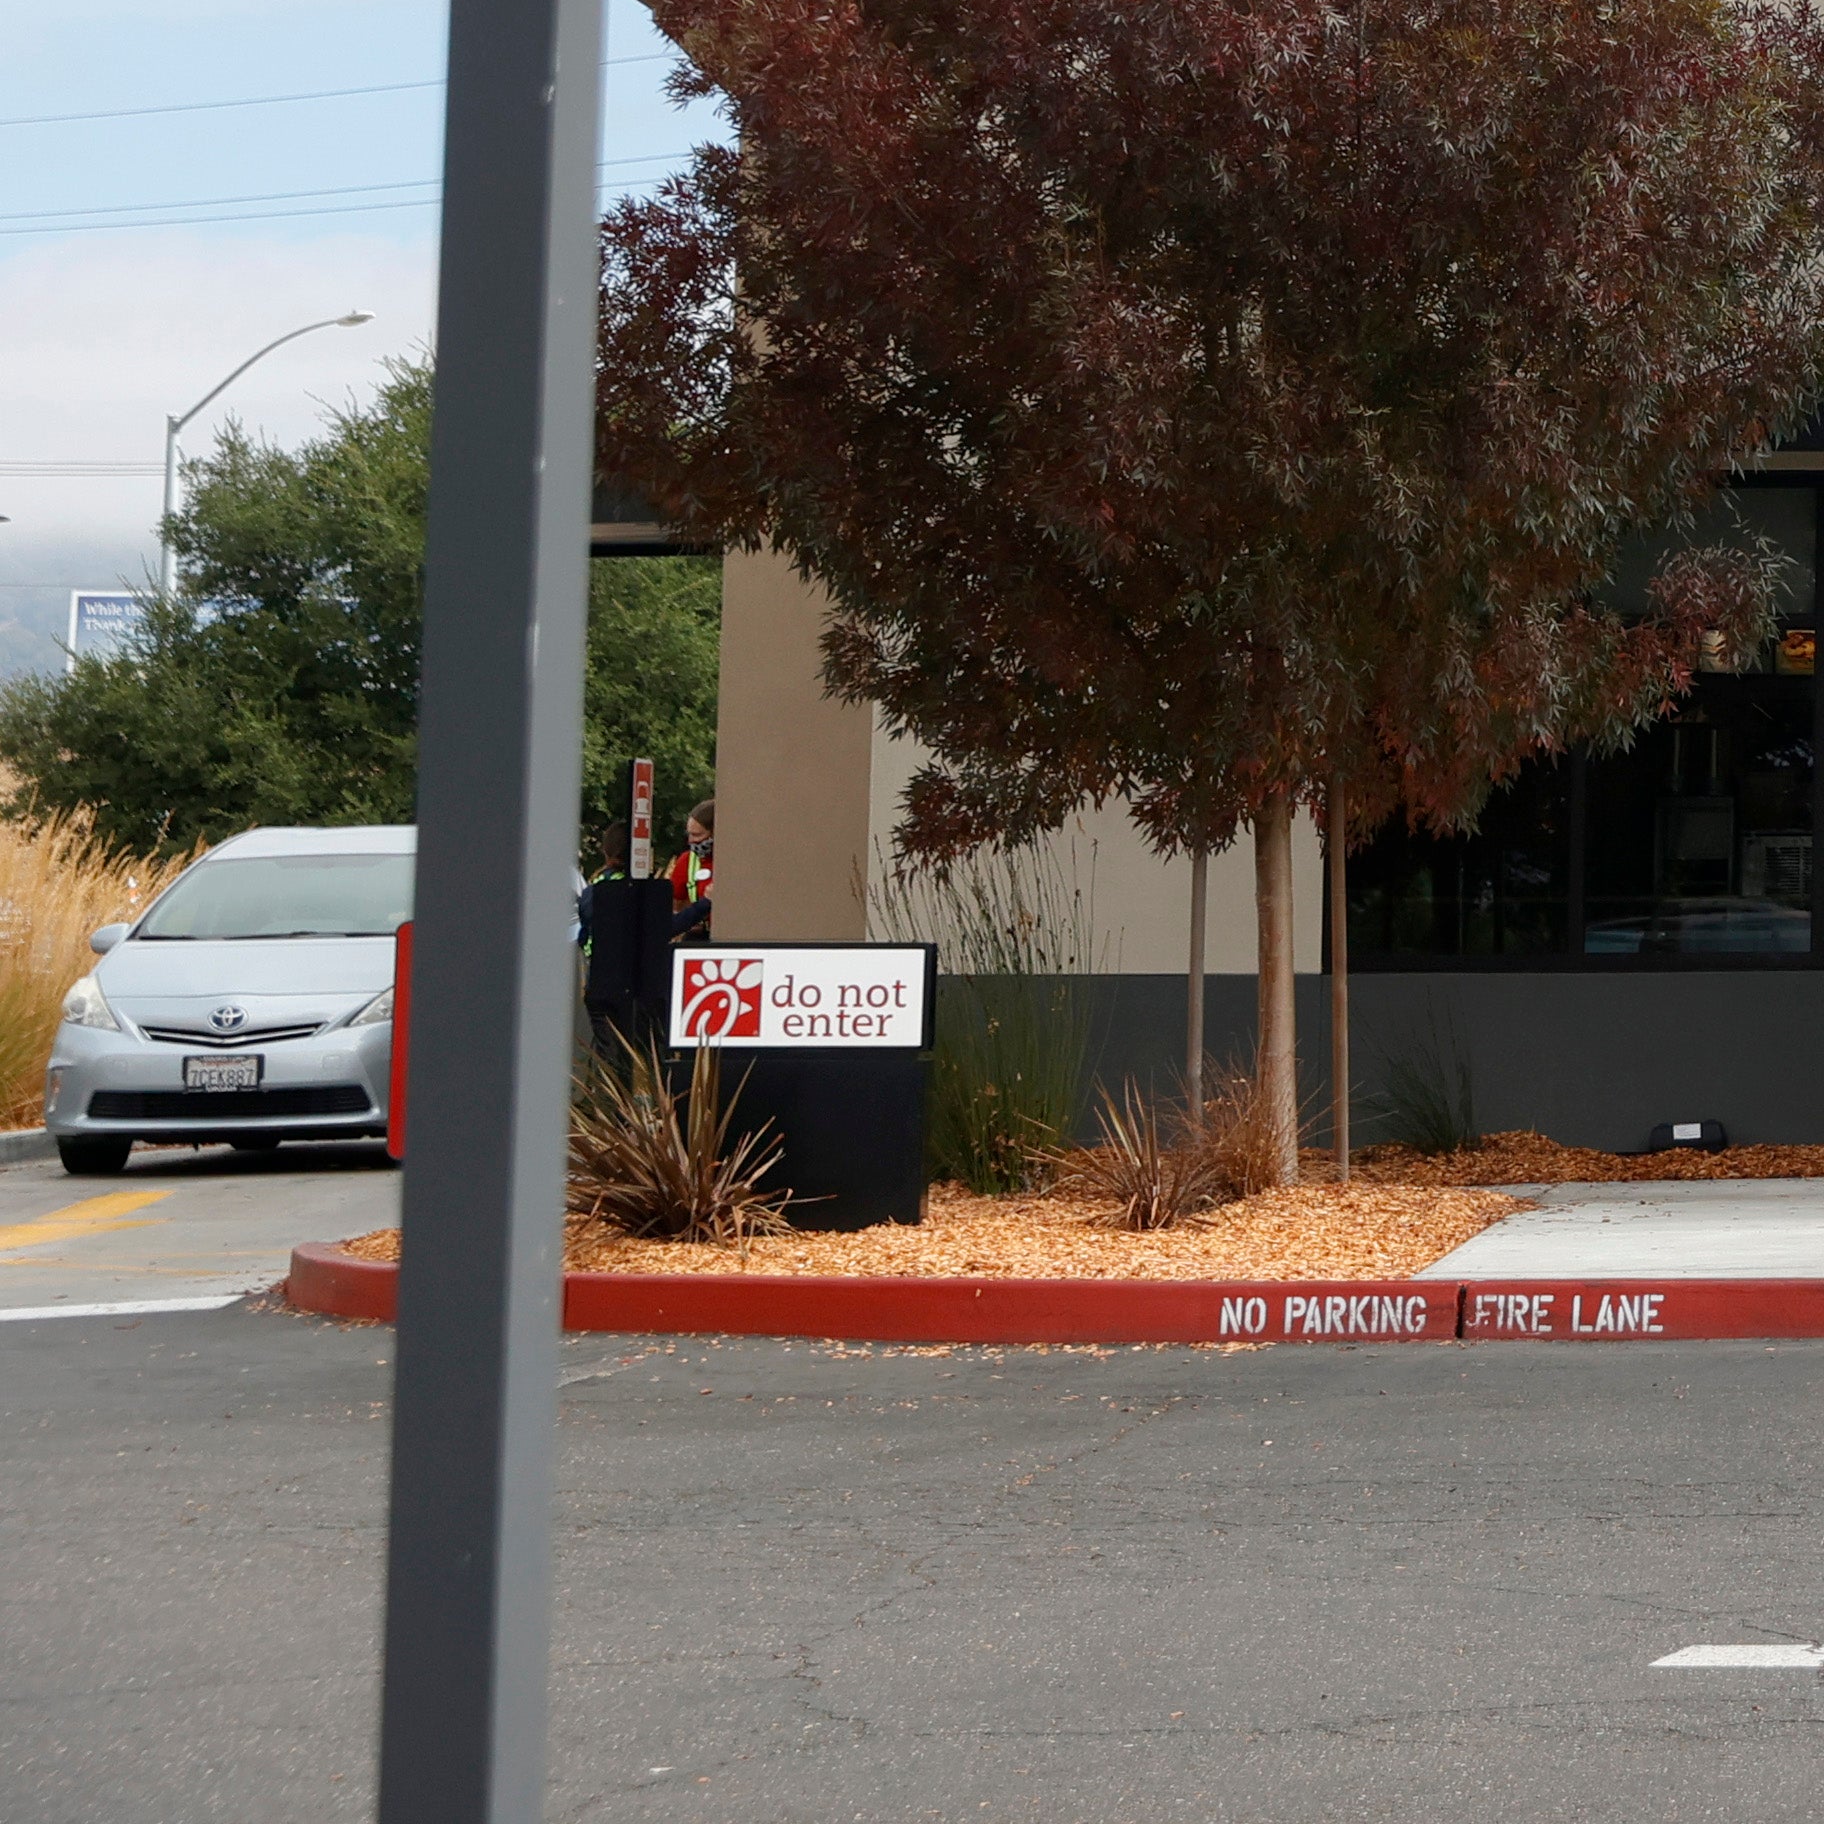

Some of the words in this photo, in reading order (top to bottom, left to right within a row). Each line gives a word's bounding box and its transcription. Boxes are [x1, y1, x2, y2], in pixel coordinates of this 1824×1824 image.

[84, 601, 122, 616] While
[771, 974, 822, 1008] do
[837, 979, 907, 1008] not
[782, 1009, 894, 1038] enter
[189, 1068, 255, 1087] 7CEK887
[1218, 1296, 1267, 1335] NO
[1283, 1295, 1427, 1334] PARKING
[1467, 1293, 1555, 1334] FIRE
[1571, 1293, 1665, 1334] LANE
